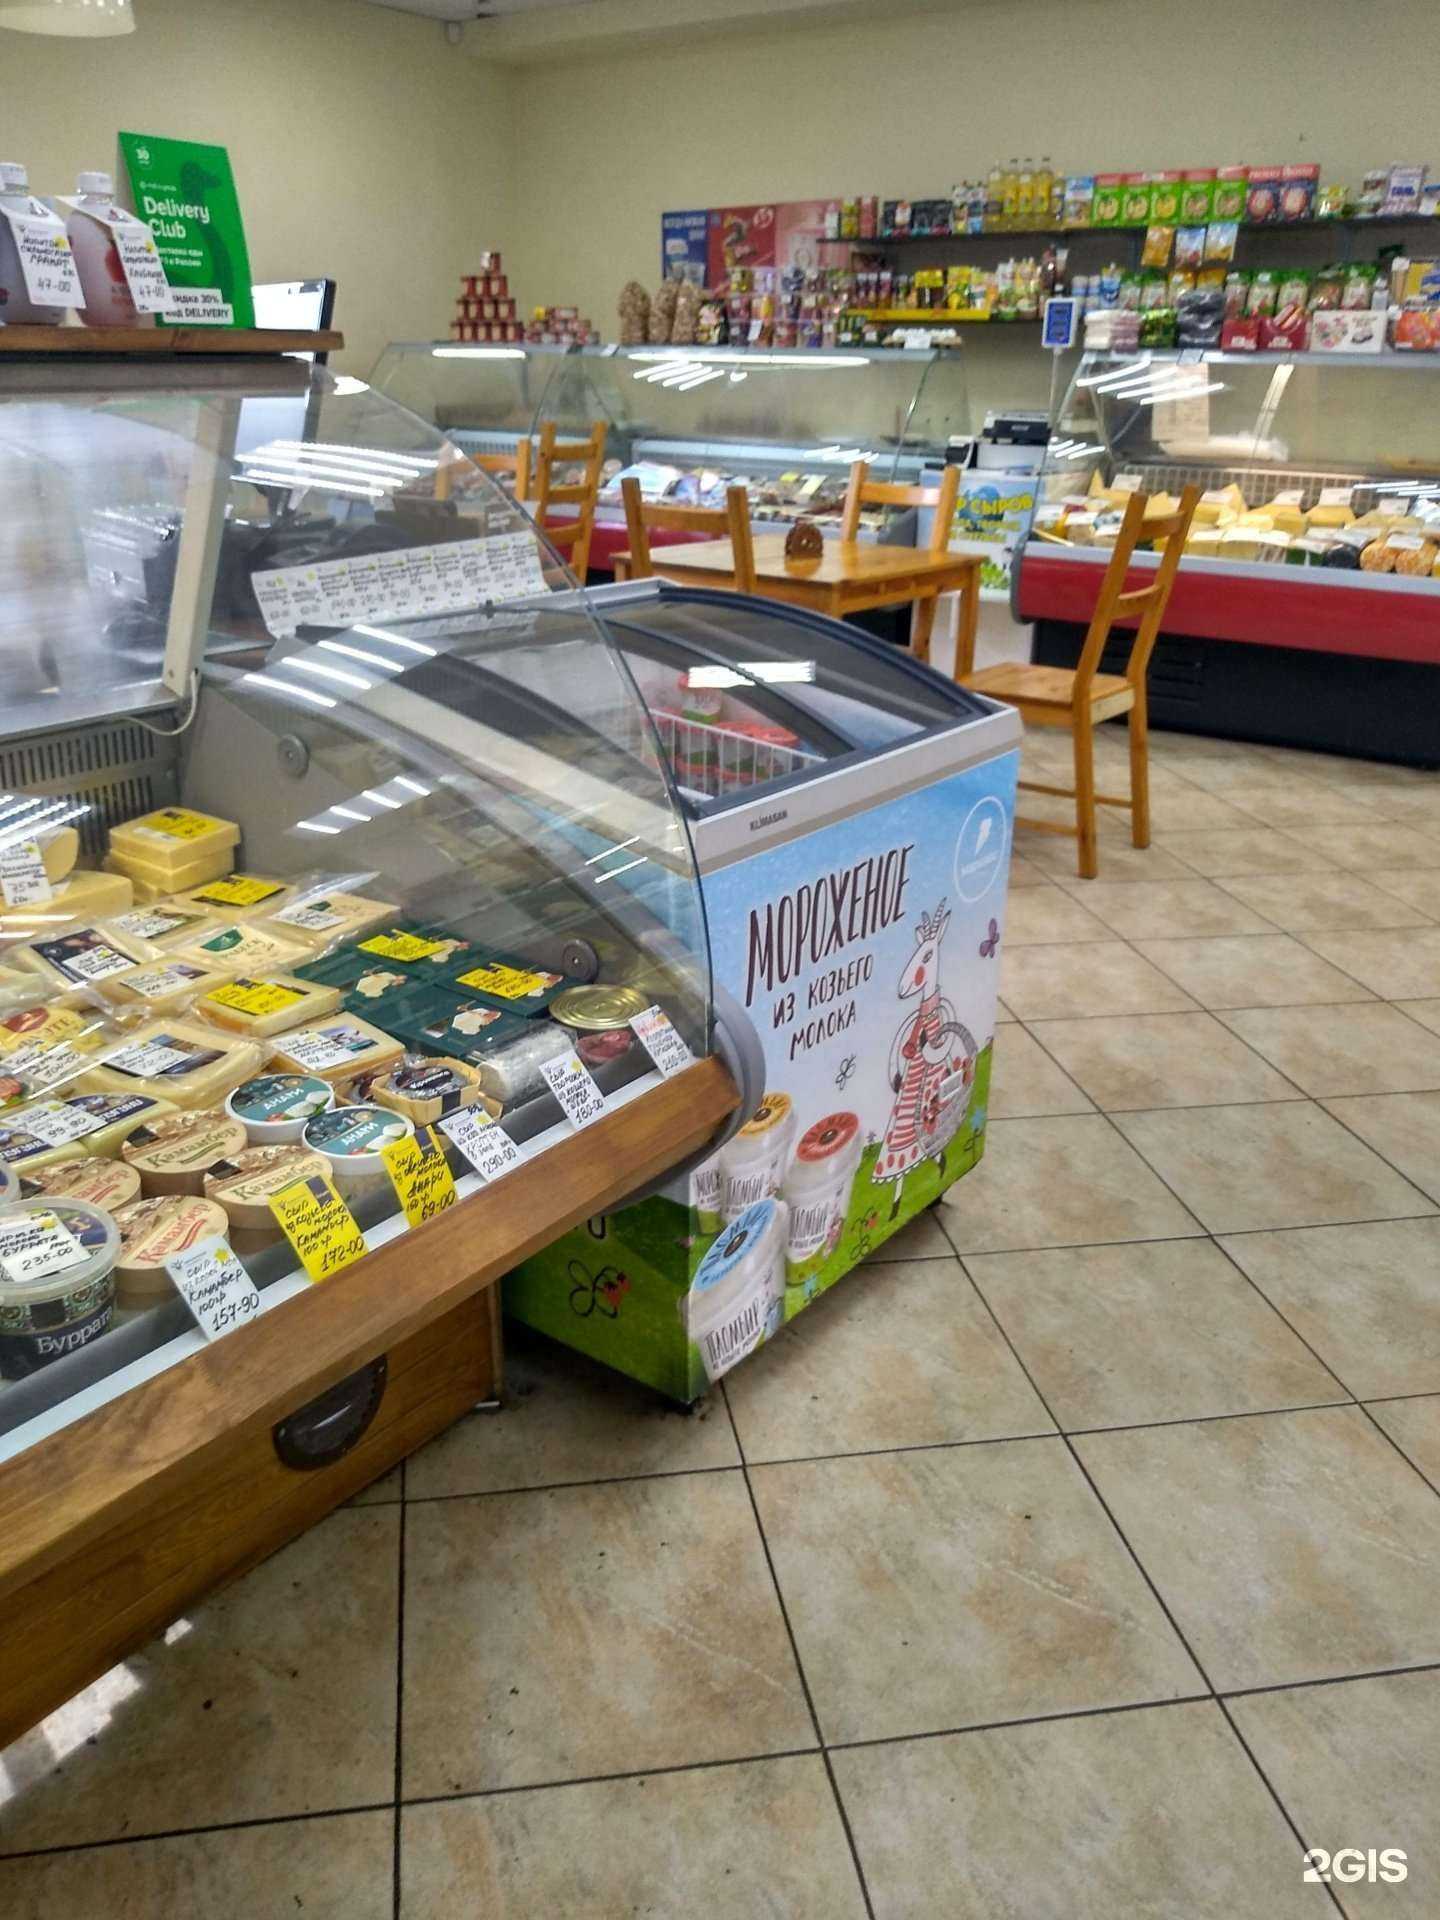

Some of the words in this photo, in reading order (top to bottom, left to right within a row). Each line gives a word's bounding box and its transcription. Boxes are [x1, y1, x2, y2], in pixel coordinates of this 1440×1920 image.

[144, 196, 210, 224] Delivery
[151, 218, 187, 239] Club
[745, 844, 915, 1008] МОРОЖЕНОЕ
[772, 991, 797, 1030] ИЗ
[807, 953, 875, 1011] КОЗЬЕГО
[789, 999, 857, 1061] МОЛОКА
[145, 1125, 239, 1169] Камамбер
[135, 1202, 210, 1264] Камамбер
[321, 1234, 365, 1273] 172-00
[22, 1246, 73, 1271] 235-00
[211, 1292, 260, 1332] 157-90
